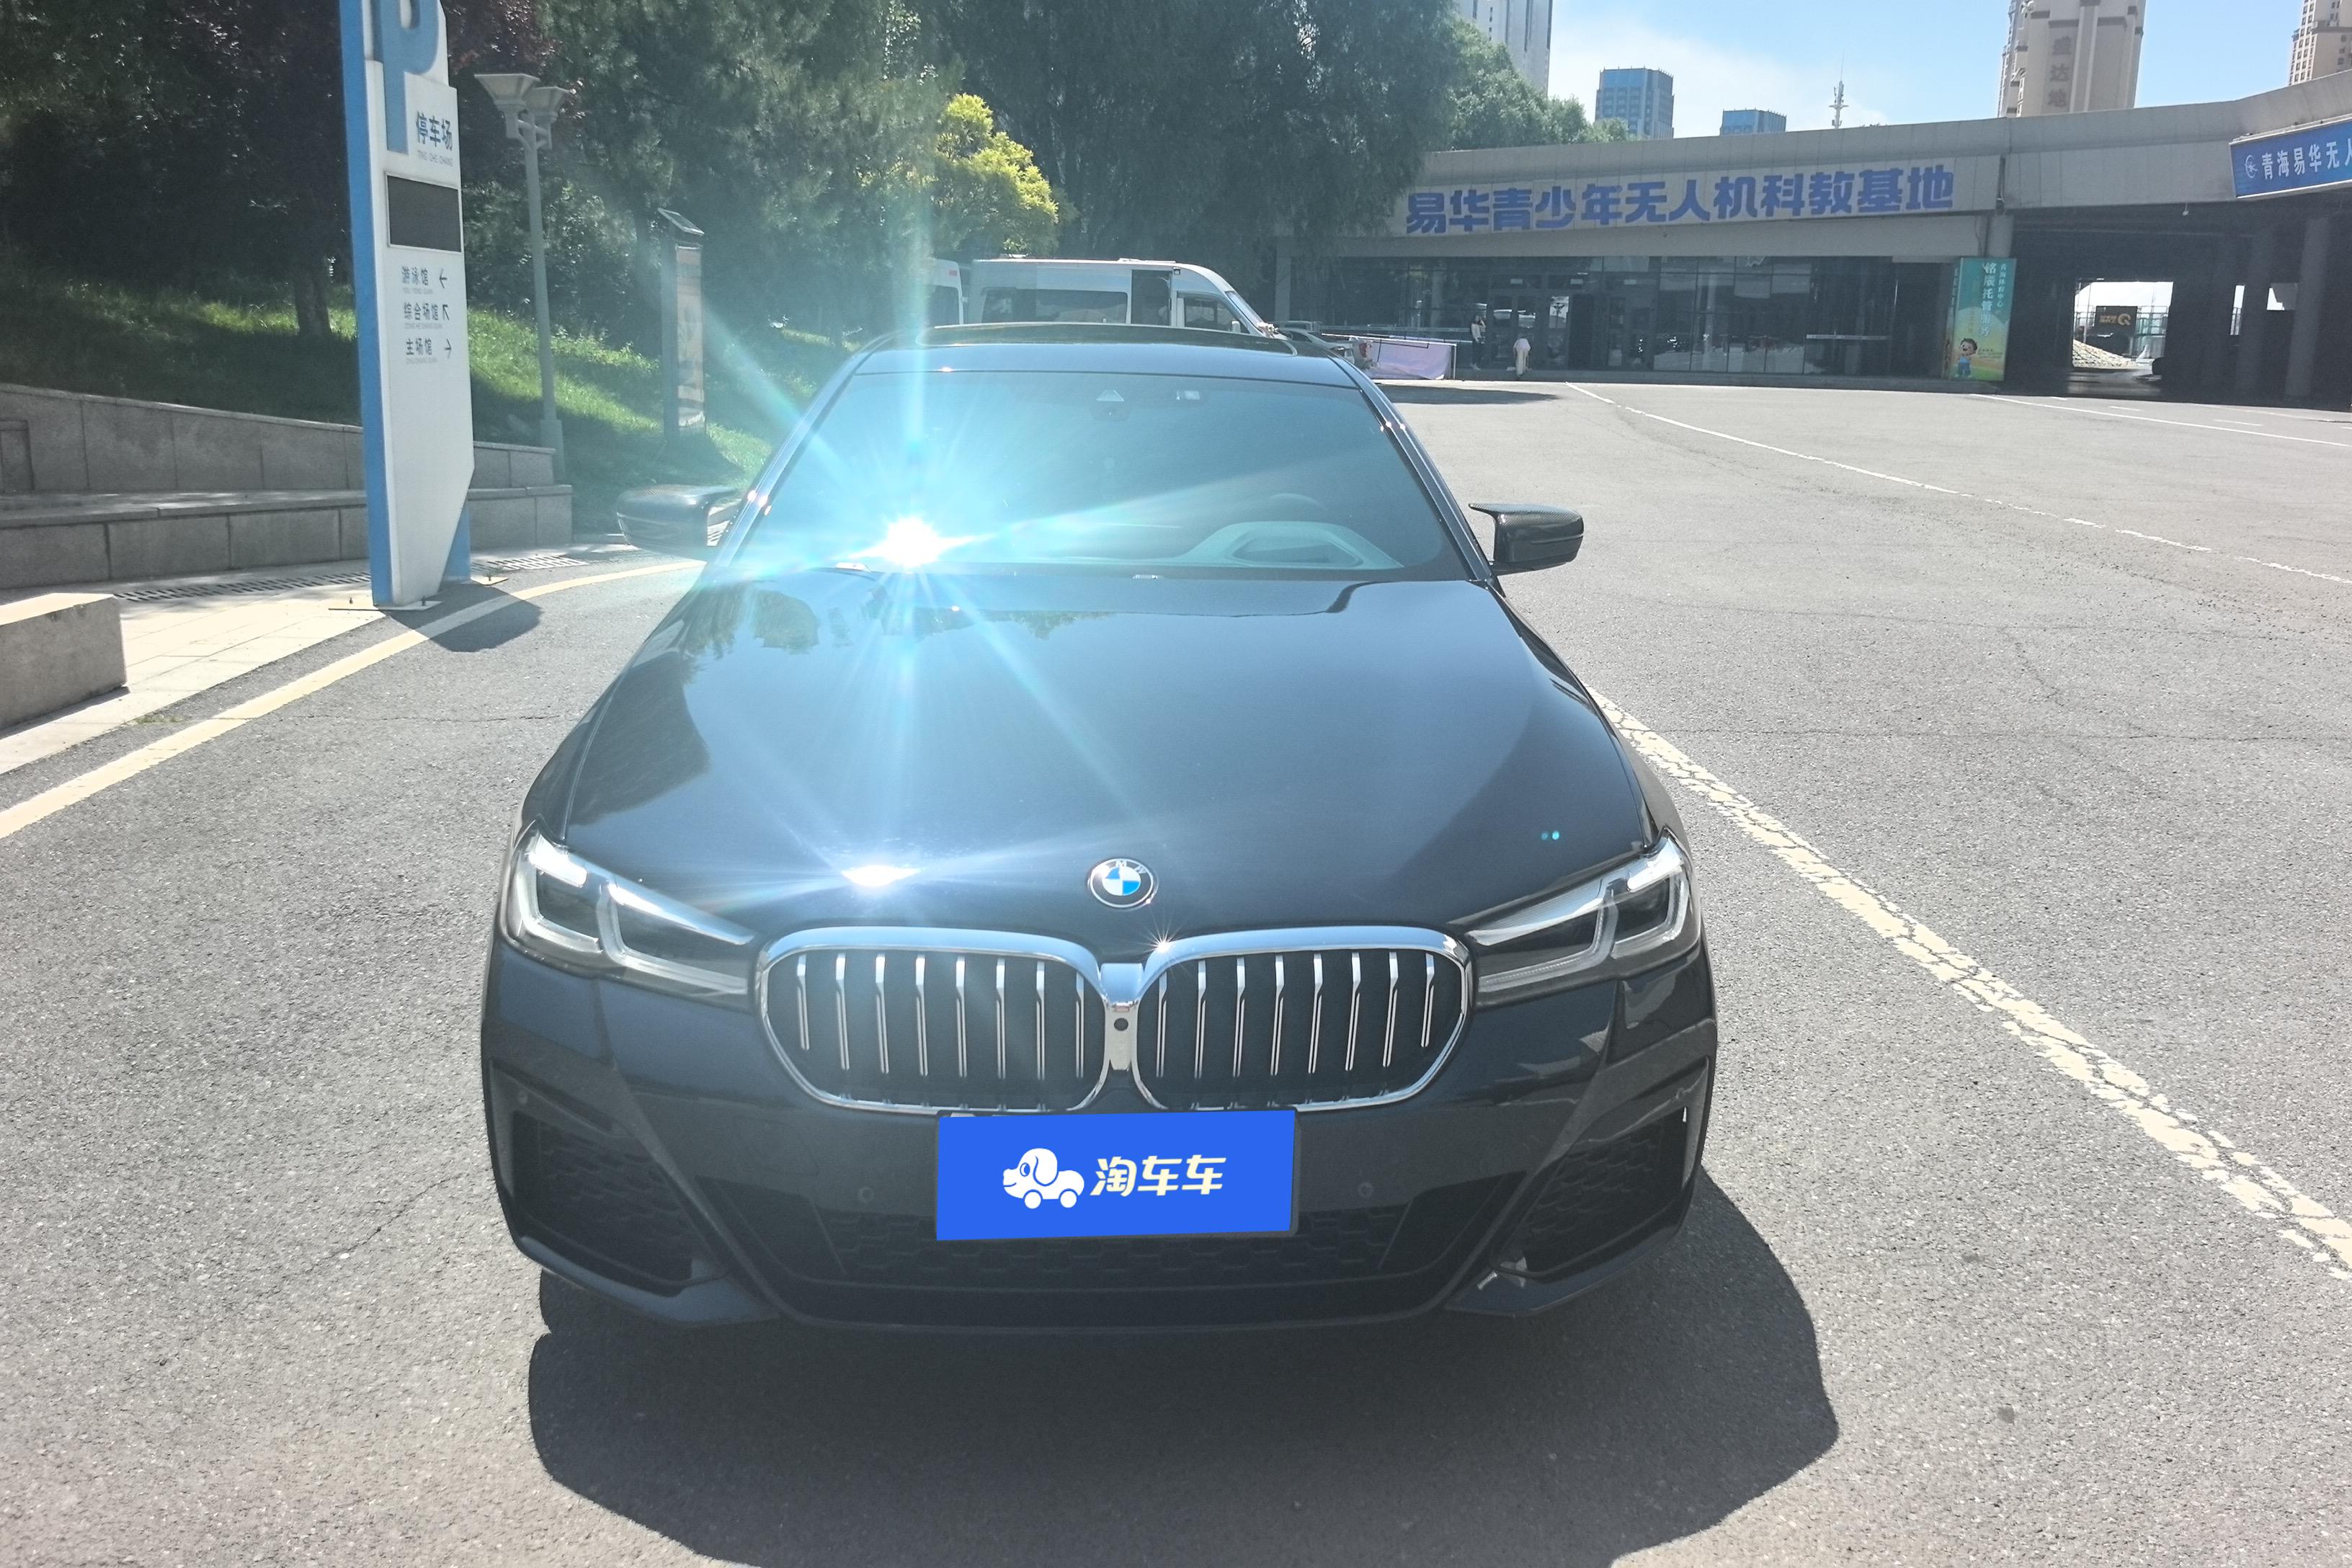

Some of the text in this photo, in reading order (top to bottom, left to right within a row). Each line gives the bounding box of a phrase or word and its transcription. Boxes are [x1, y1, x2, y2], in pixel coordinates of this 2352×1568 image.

[416, 111, 453, 151] 停车场
[1406, 164, 1954, 233] 易华青少年无人机科教基地
[402, 267, 429, 285] 游泳馆
[404, 303, 438, 321] 综合场馆
[406, 338, 432, 355] 主场馆
